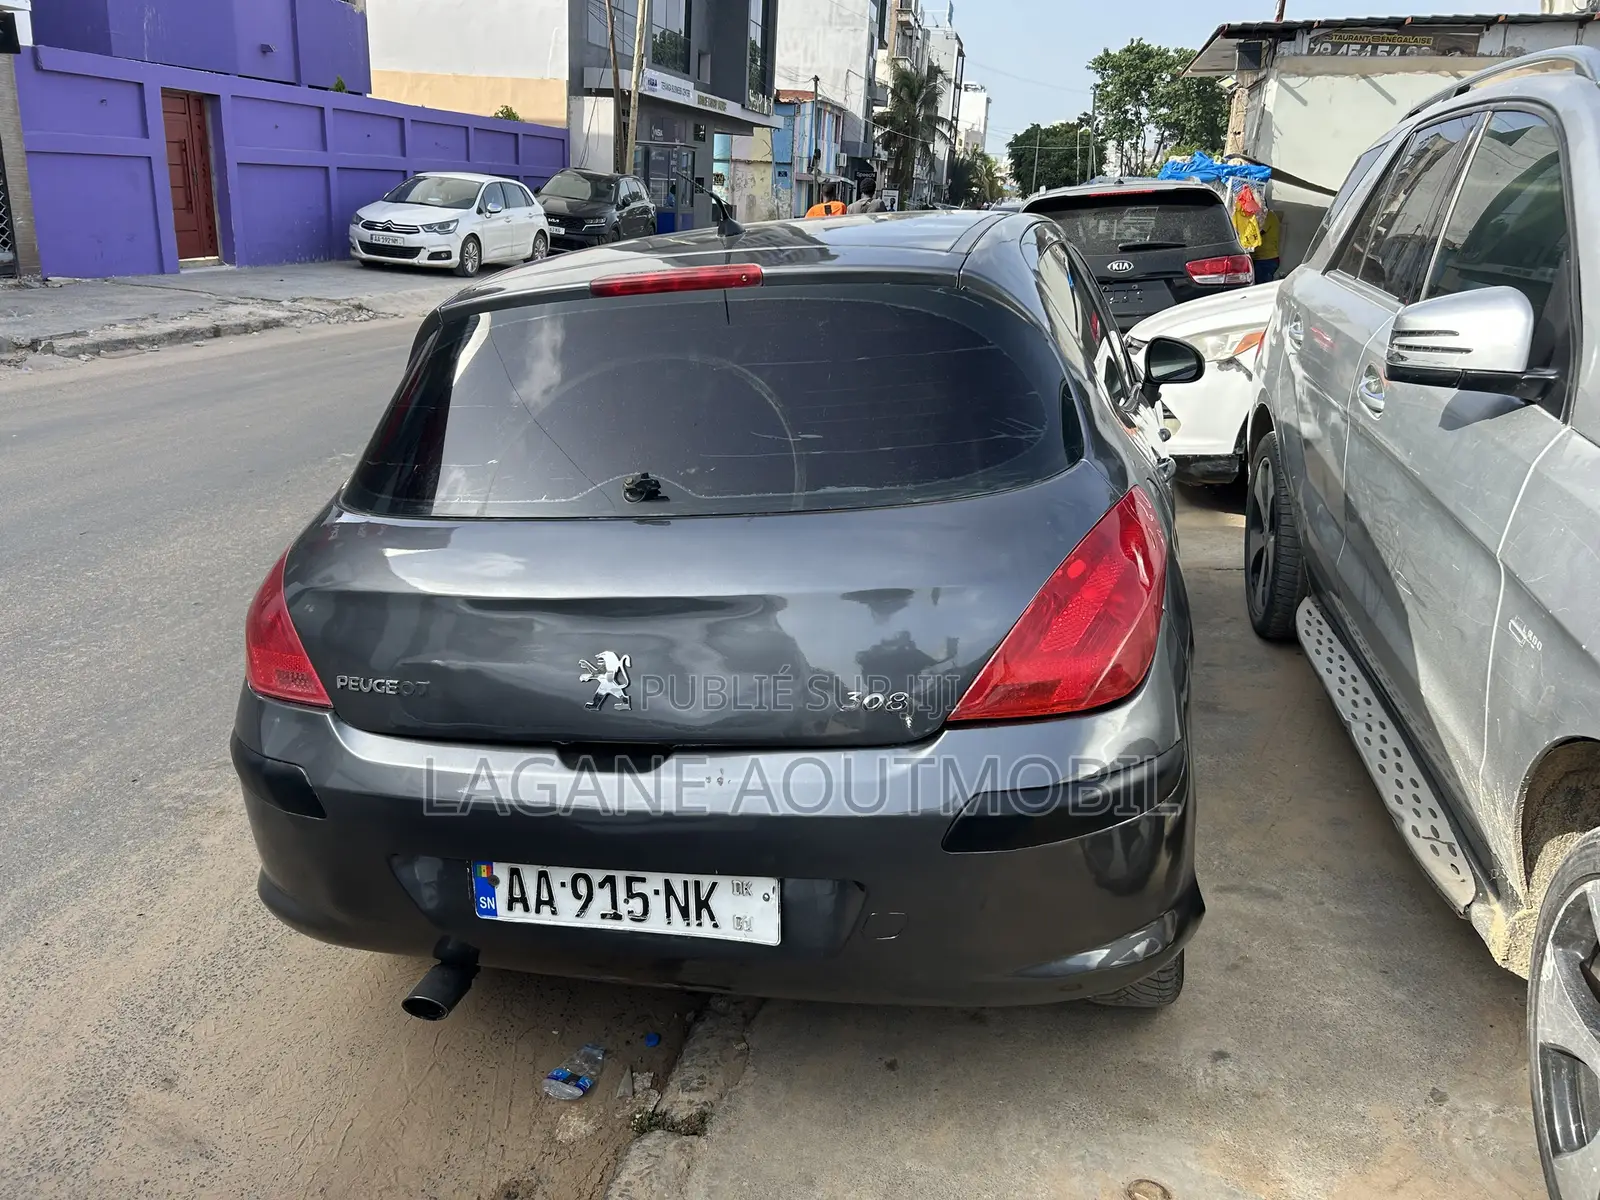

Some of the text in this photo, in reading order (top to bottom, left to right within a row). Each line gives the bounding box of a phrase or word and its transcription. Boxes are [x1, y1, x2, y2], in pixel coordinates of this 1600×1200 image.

[1322, 33, 1372, 44] STAURANT
[1111, 262, 1131, 271] KIA
[336, 674, 431, 697] PEUGEOT
[838, 690, 910, 712] 308
[479, 896, 496, 910] SN
